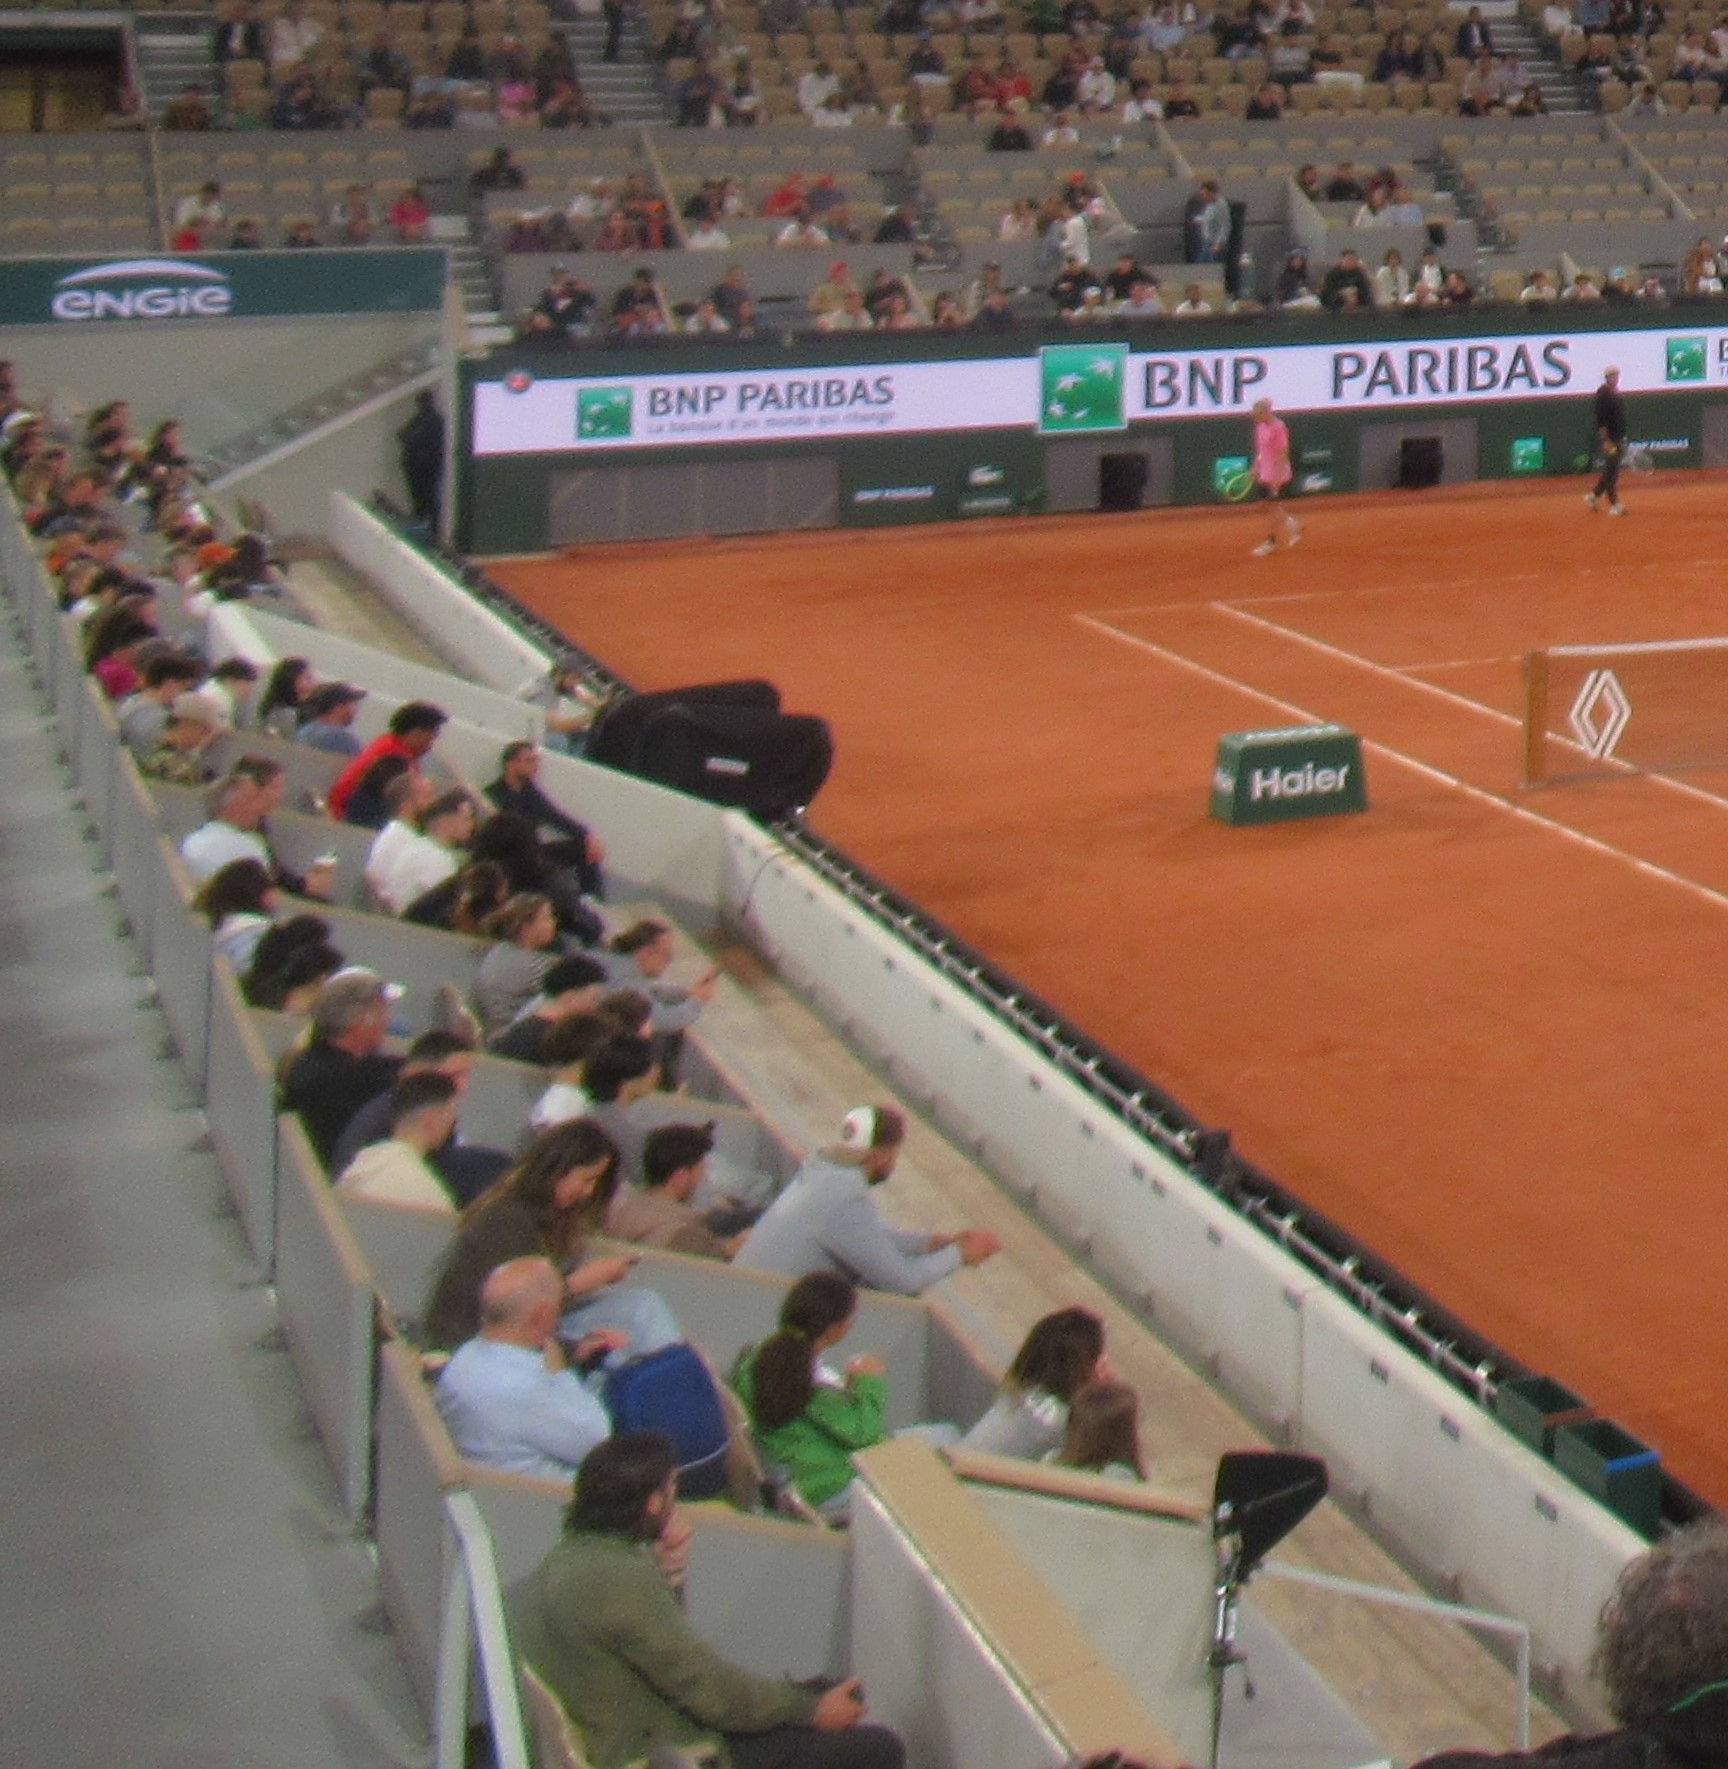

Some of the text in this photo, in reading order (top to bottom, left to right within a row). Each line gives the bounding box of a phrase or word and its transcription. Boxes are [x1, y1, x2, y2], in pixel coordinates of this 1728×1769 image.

[1143, 340, 1573, 409] BNP PARIBAS
[648, 376, 896, 417] BNP PARIBAS
[1250, 761, 1350, 802] Haier
